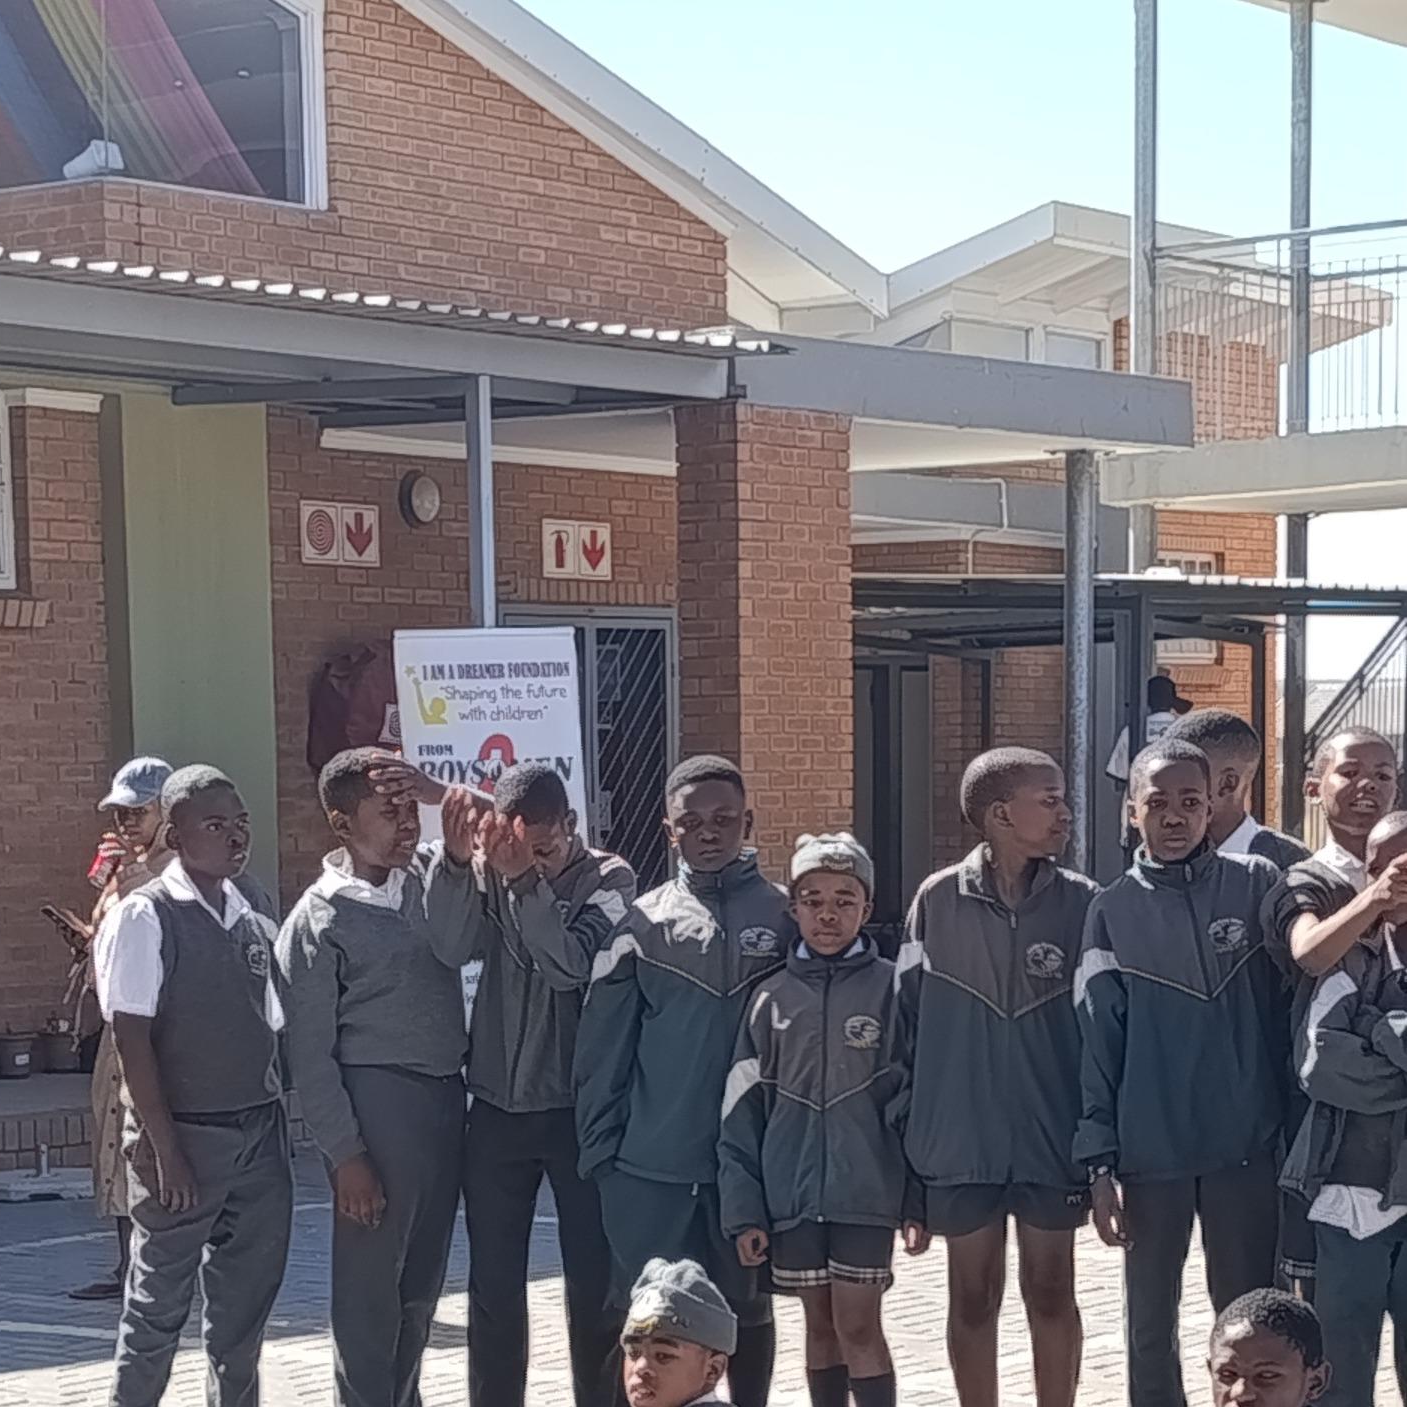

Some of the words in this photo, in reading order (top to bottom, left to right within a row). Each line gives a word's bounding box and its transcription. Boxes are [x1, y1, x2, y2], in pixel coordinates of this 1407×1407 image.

[421, 664, 428, 682] I
[430, 664, 445, 681] AM
[448, 664, 455, 680] A
[457, 663, 505, 680] DREAMER
[507, 661, 570, 679] FOUNDATION
[500, 683, 523, 700] the
[526, 683, 568, 699] future
[458, 705, 487, 722] with
[418, 744, 454, 757] FROM
